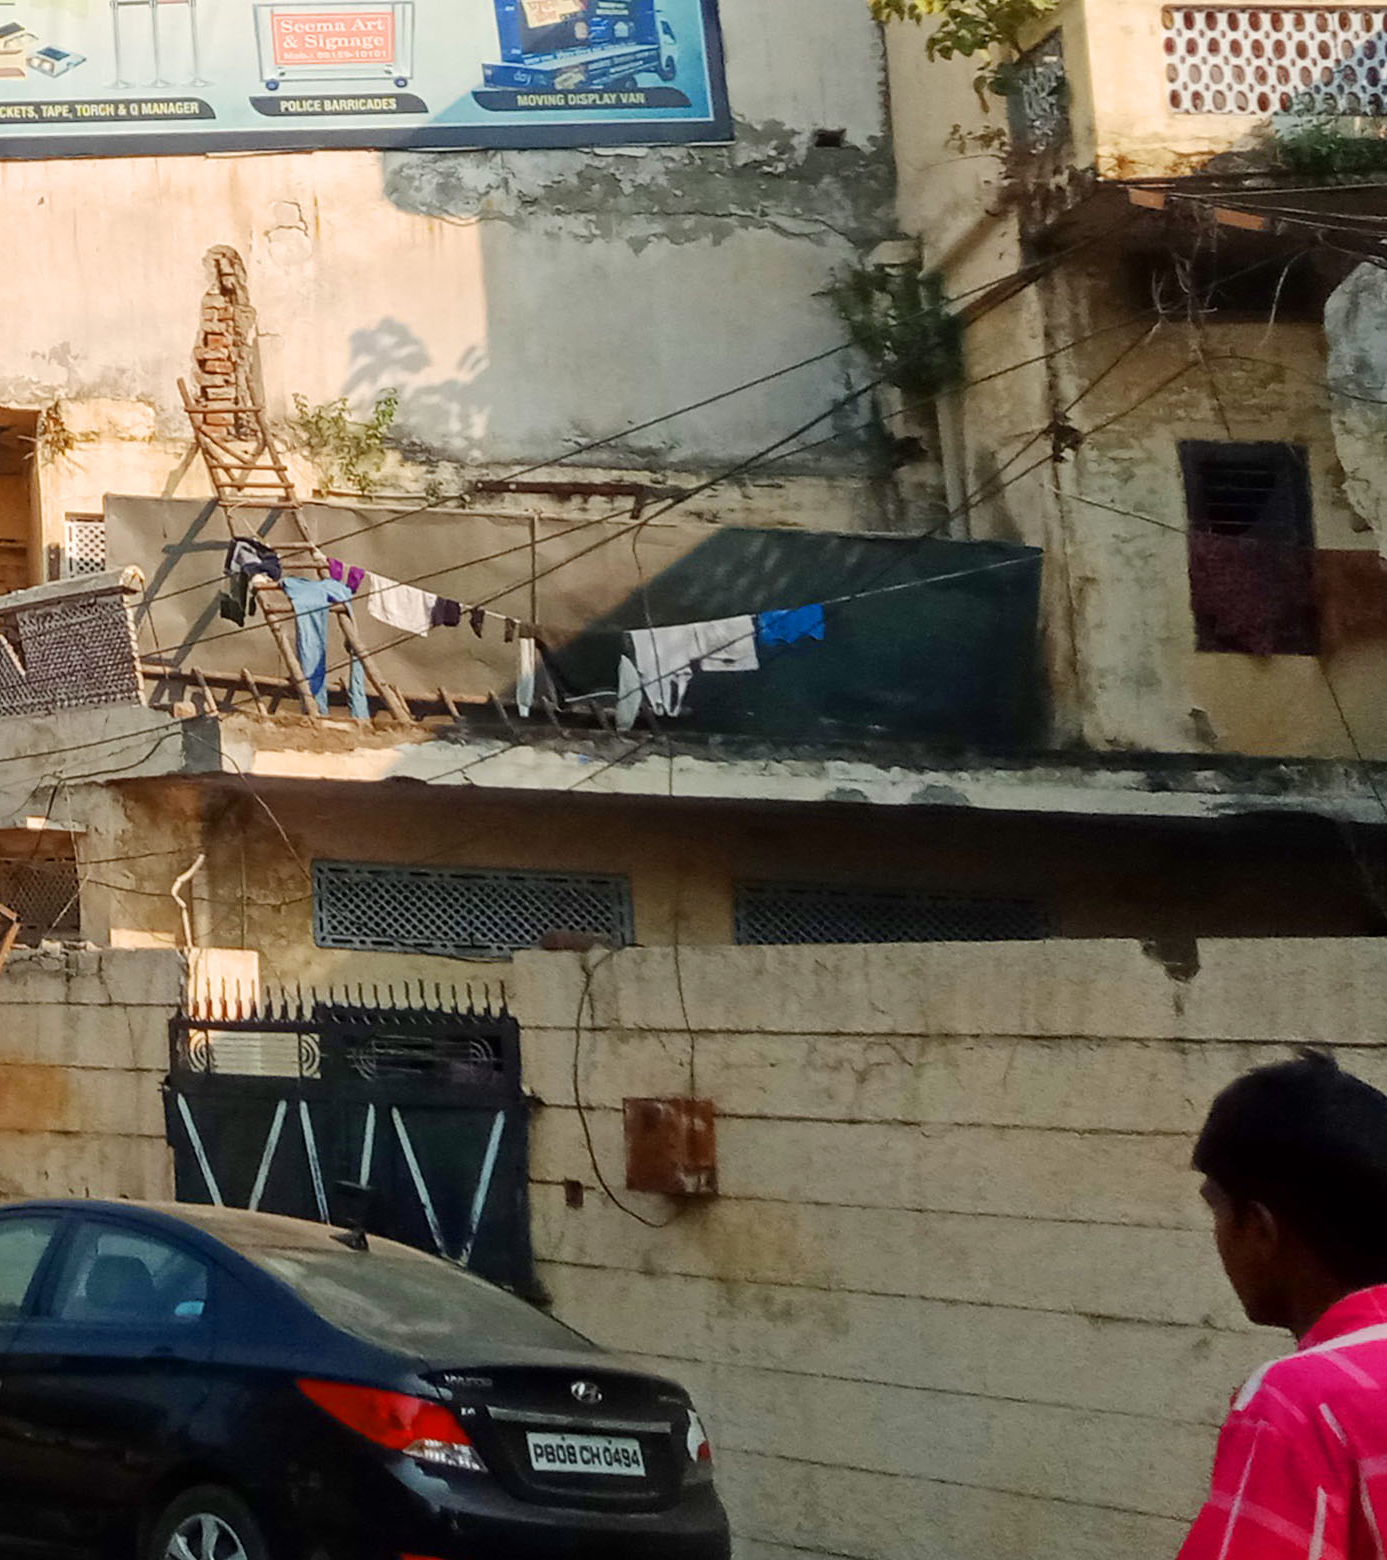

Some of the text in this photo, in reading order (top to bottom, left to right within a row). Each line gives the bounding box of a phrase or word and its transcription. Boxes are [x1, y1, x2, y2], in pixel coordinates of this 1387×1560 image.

[280, 17, 385, 35] Seema Art
[282, 34, 385, 51] & Signage
[280, 97, 397, 113] POLICE BARRICADES
[517, 92, 646, 107] MOVING DISPLAY VAN
[41, 104, 72, 120] TAPE,
[75, 103, 115, 117] TORCH
[118, 103, 128, 116] &
[141, 101, 199, 115] MANAGER
[533, 1443, 577, 1465] PB08
[580, 1445, 603, 1465] CH
